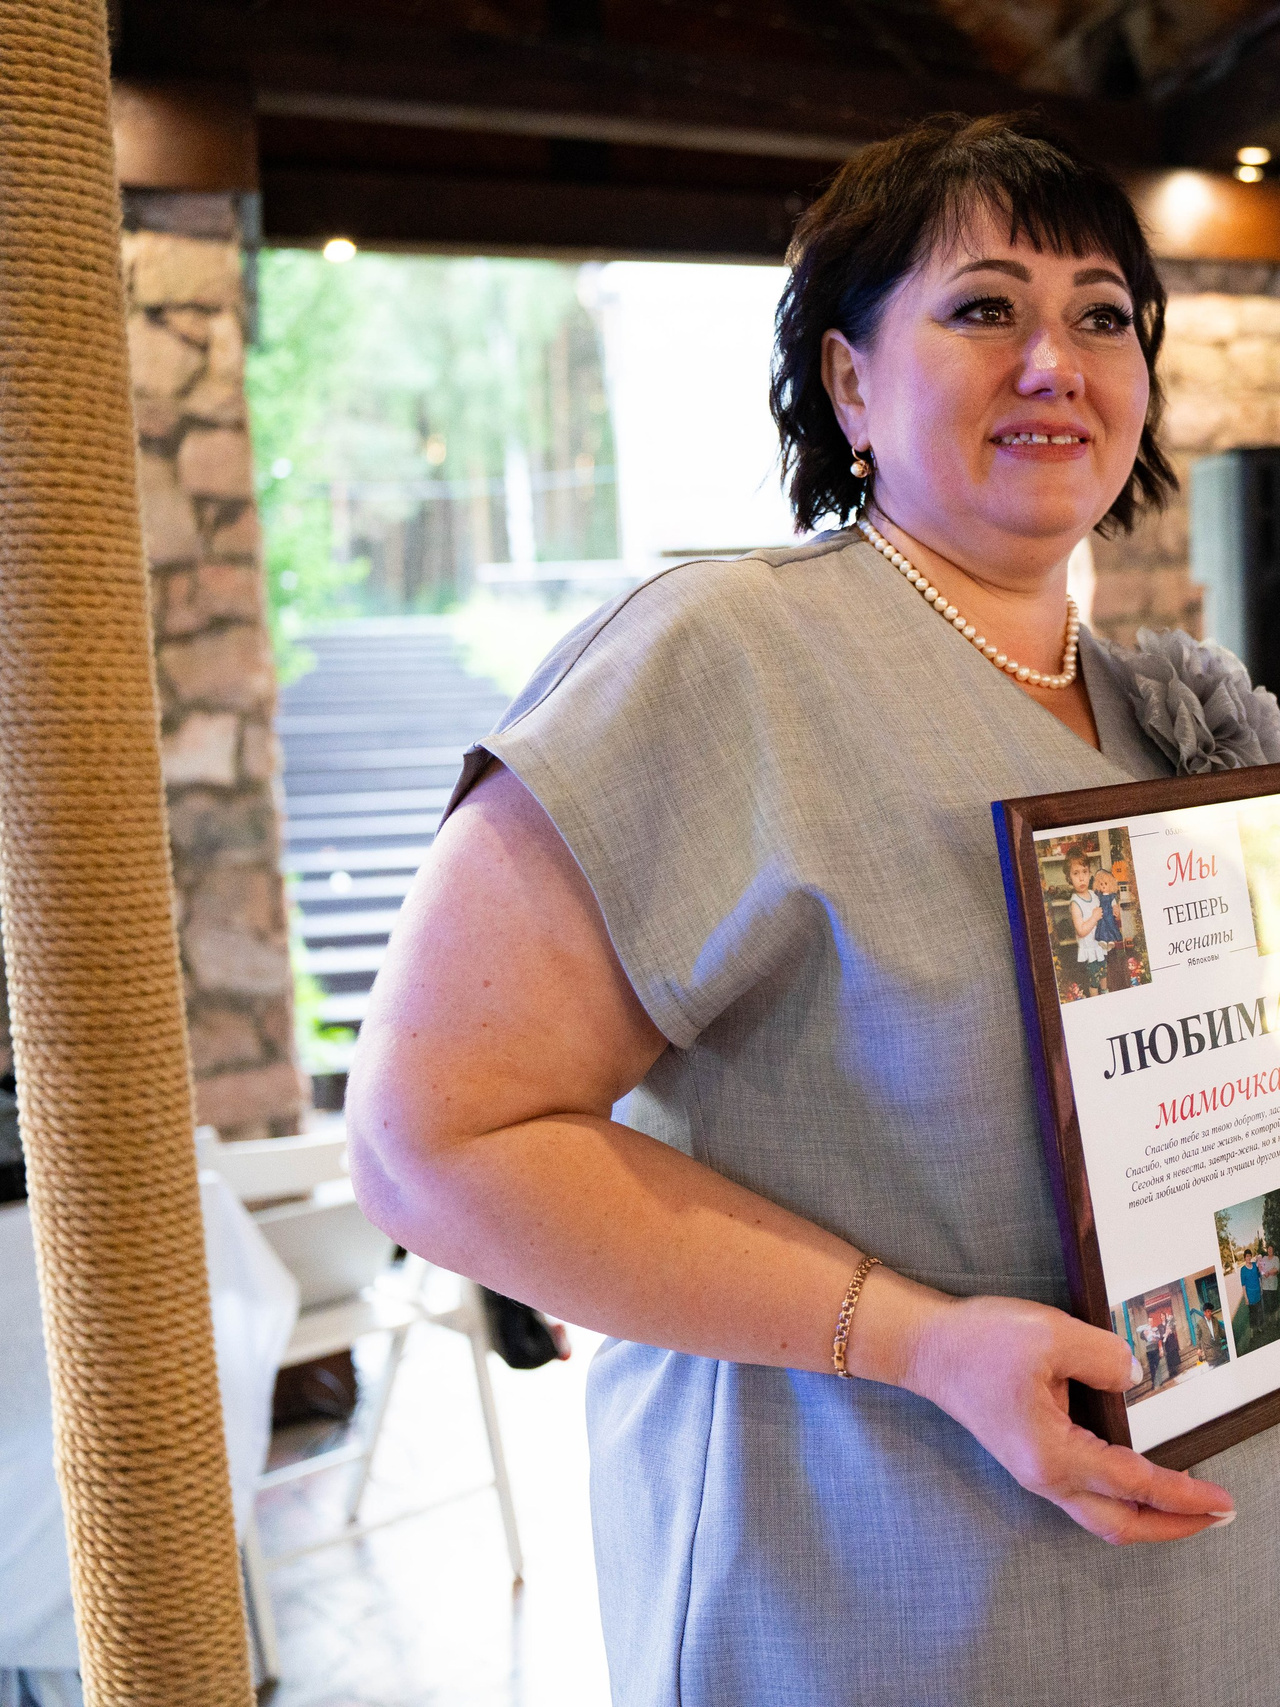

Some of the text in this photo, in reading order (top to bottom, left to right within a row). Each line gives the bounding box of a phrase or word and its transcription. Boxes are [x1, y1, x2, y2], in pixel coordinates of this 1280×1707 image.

[1166, 848, 1218, 887] Мы
[1162, 895, 1229, 926] ТЕПЕРЬ
[1168, 928, 1234, 956] женаты
[1187, 953, 1220, 968] Яблоковы
[1125, 1160, 1162, 1179] Спасибо,
[1163, 1154, 1180, 1165] что
[1181, 1147, 1200, 1160] дала
[1200, 1143, 1216, 1154] мне
[1217, 1134, 1244, 1148] жизнь,
[1245, 1131, 1250, 1139] в
[1145, 1138, 1178, 1156] Спасибо
[1180, 1131, 1200, 1145] тебе
[1201, 1129, 1210, 1139] за
[1211, 1121, 1232, 1135] твою
[1131, 1173, 1165, 1192] Сегодня
[1166, 1172, 1171, 1181] я
[1172, 1160, 1207, 1179] невеста,
[1261, 1138, 1271, 1148] но
[1271, 1136, 1277, 1144] я
[1128, 1192, 1154, 1209] твоей
[1155, 1179, 1191, 1201] любимой
[1192, 1169, 1219, 1187] дочкой
[1220, 1169, 1225, 1177] и
[1226, 1158, 1255, 1176] лучшим
